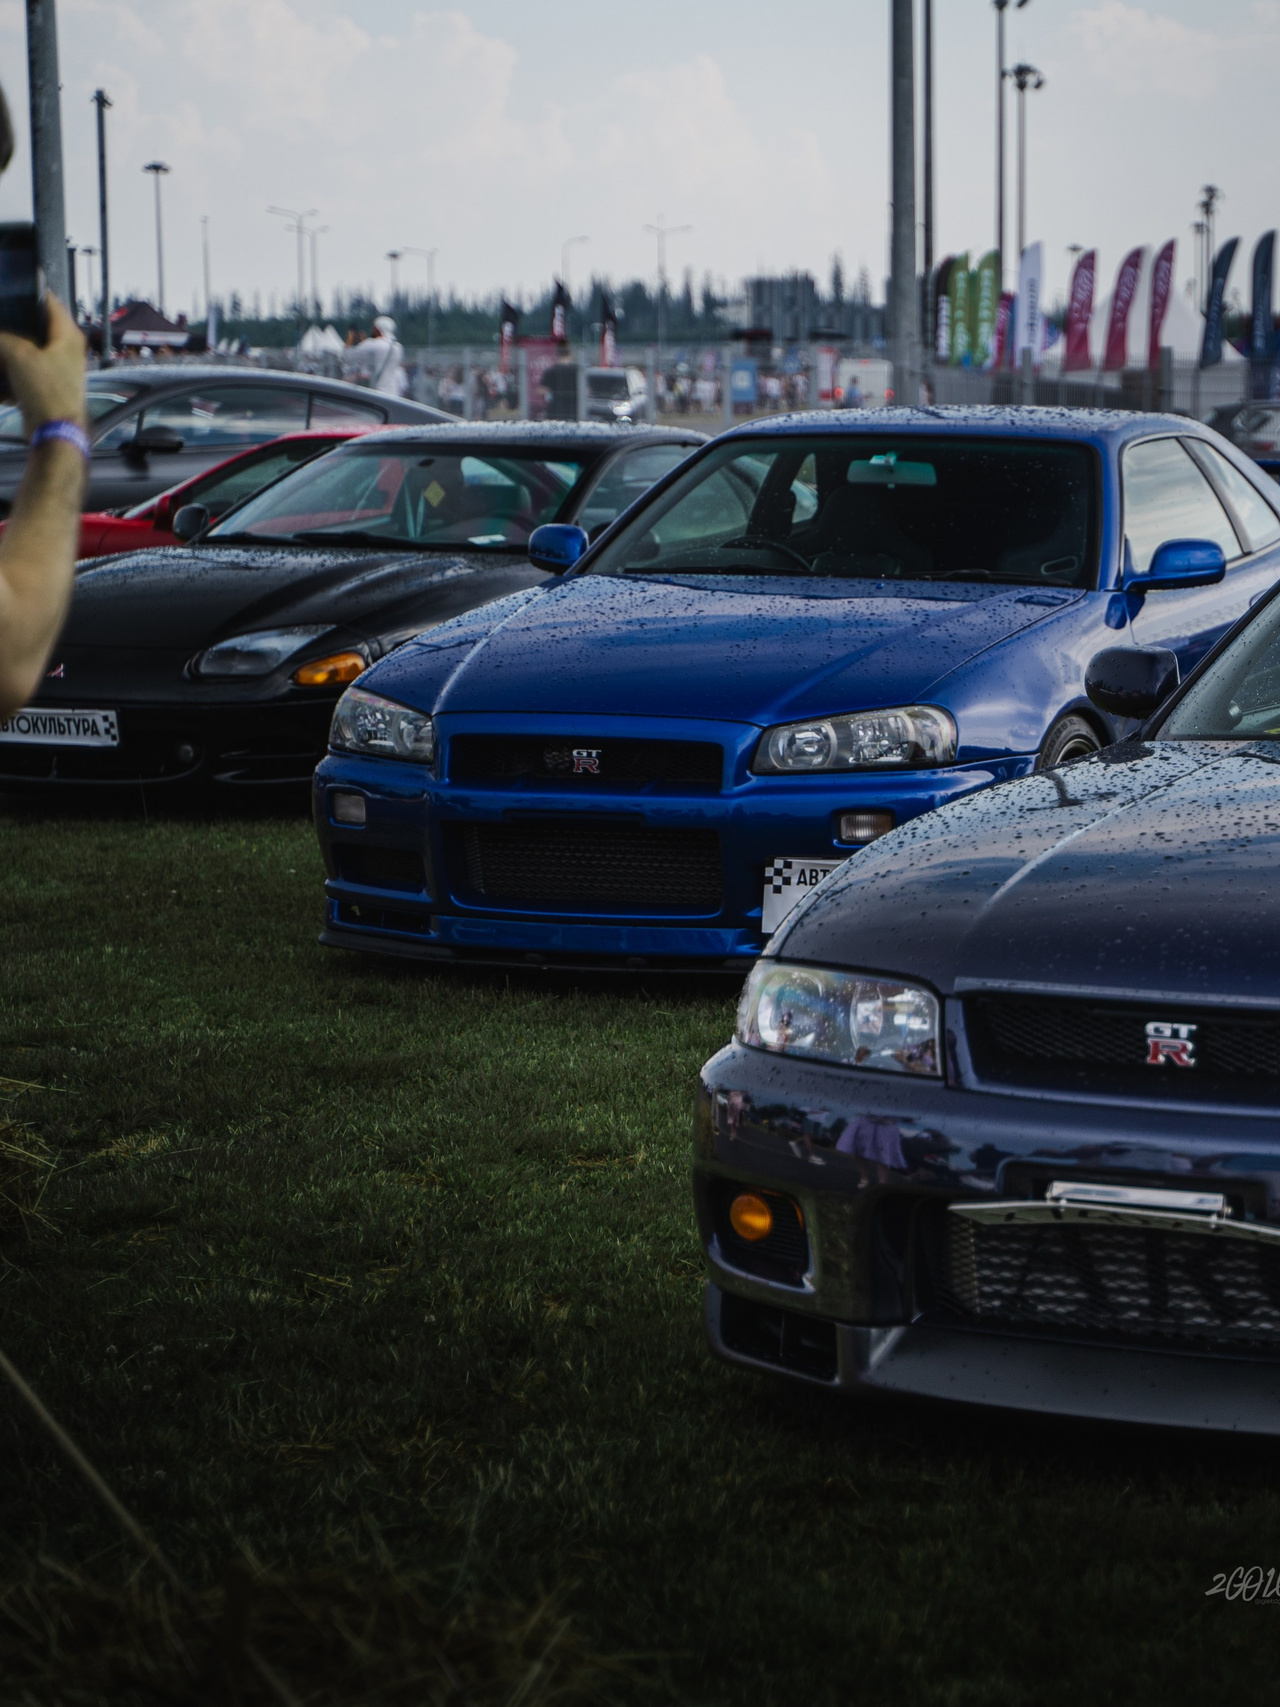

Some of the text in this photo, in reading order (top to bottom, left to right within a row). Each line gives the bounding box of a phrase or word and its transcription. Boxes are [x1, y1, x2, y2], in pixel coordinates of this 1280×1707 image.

[0, 714, 101, 737] ВТОКУЛЬТУРА
[1145, 1021, 1198, 1039] GT
[1146, 1037, 1196, 1067] R
